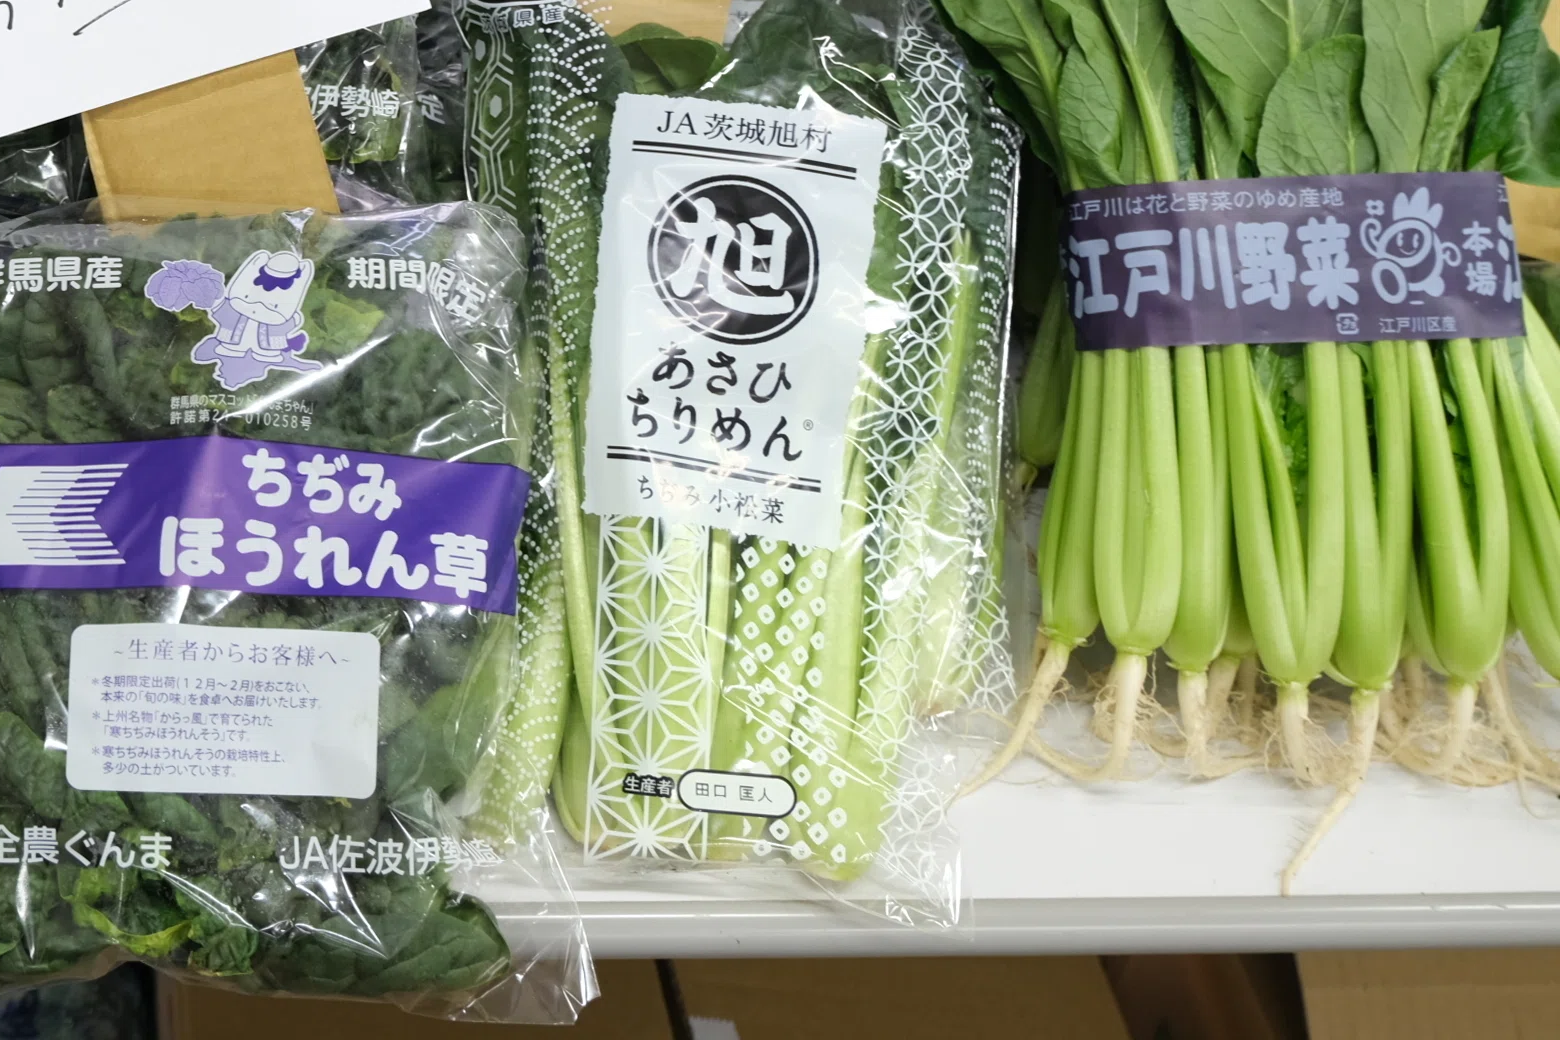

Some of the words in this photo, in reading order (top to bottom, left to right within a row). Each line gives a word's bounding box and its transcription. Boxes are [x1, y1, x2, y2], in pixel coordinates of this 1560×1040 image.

[304, 84, 401, 119] 伊勢崎
[1069, 186, 1344, 222] 江戸川は花と野菜のゆめ産地
[347, 256, 487, 323] 期間限定
[671, 197, 796, 316] 旭
[1069, 217, 1360, 319] 江戸川野菜
[1462, 221, 1498, 297] 本場
[1379, 316, 1457, 334] 江戸川区産
[652, 341, 792, 404] あさひ
[627, 387, 804, 462] ちりめん
[243, 448, 402, 521] ちぢみ
[159, 516, 489, 599] ほうれん草
[624, 775, 673, 796] 生産者
[280, 835, 506, 876] JA佐波伊勢崎
